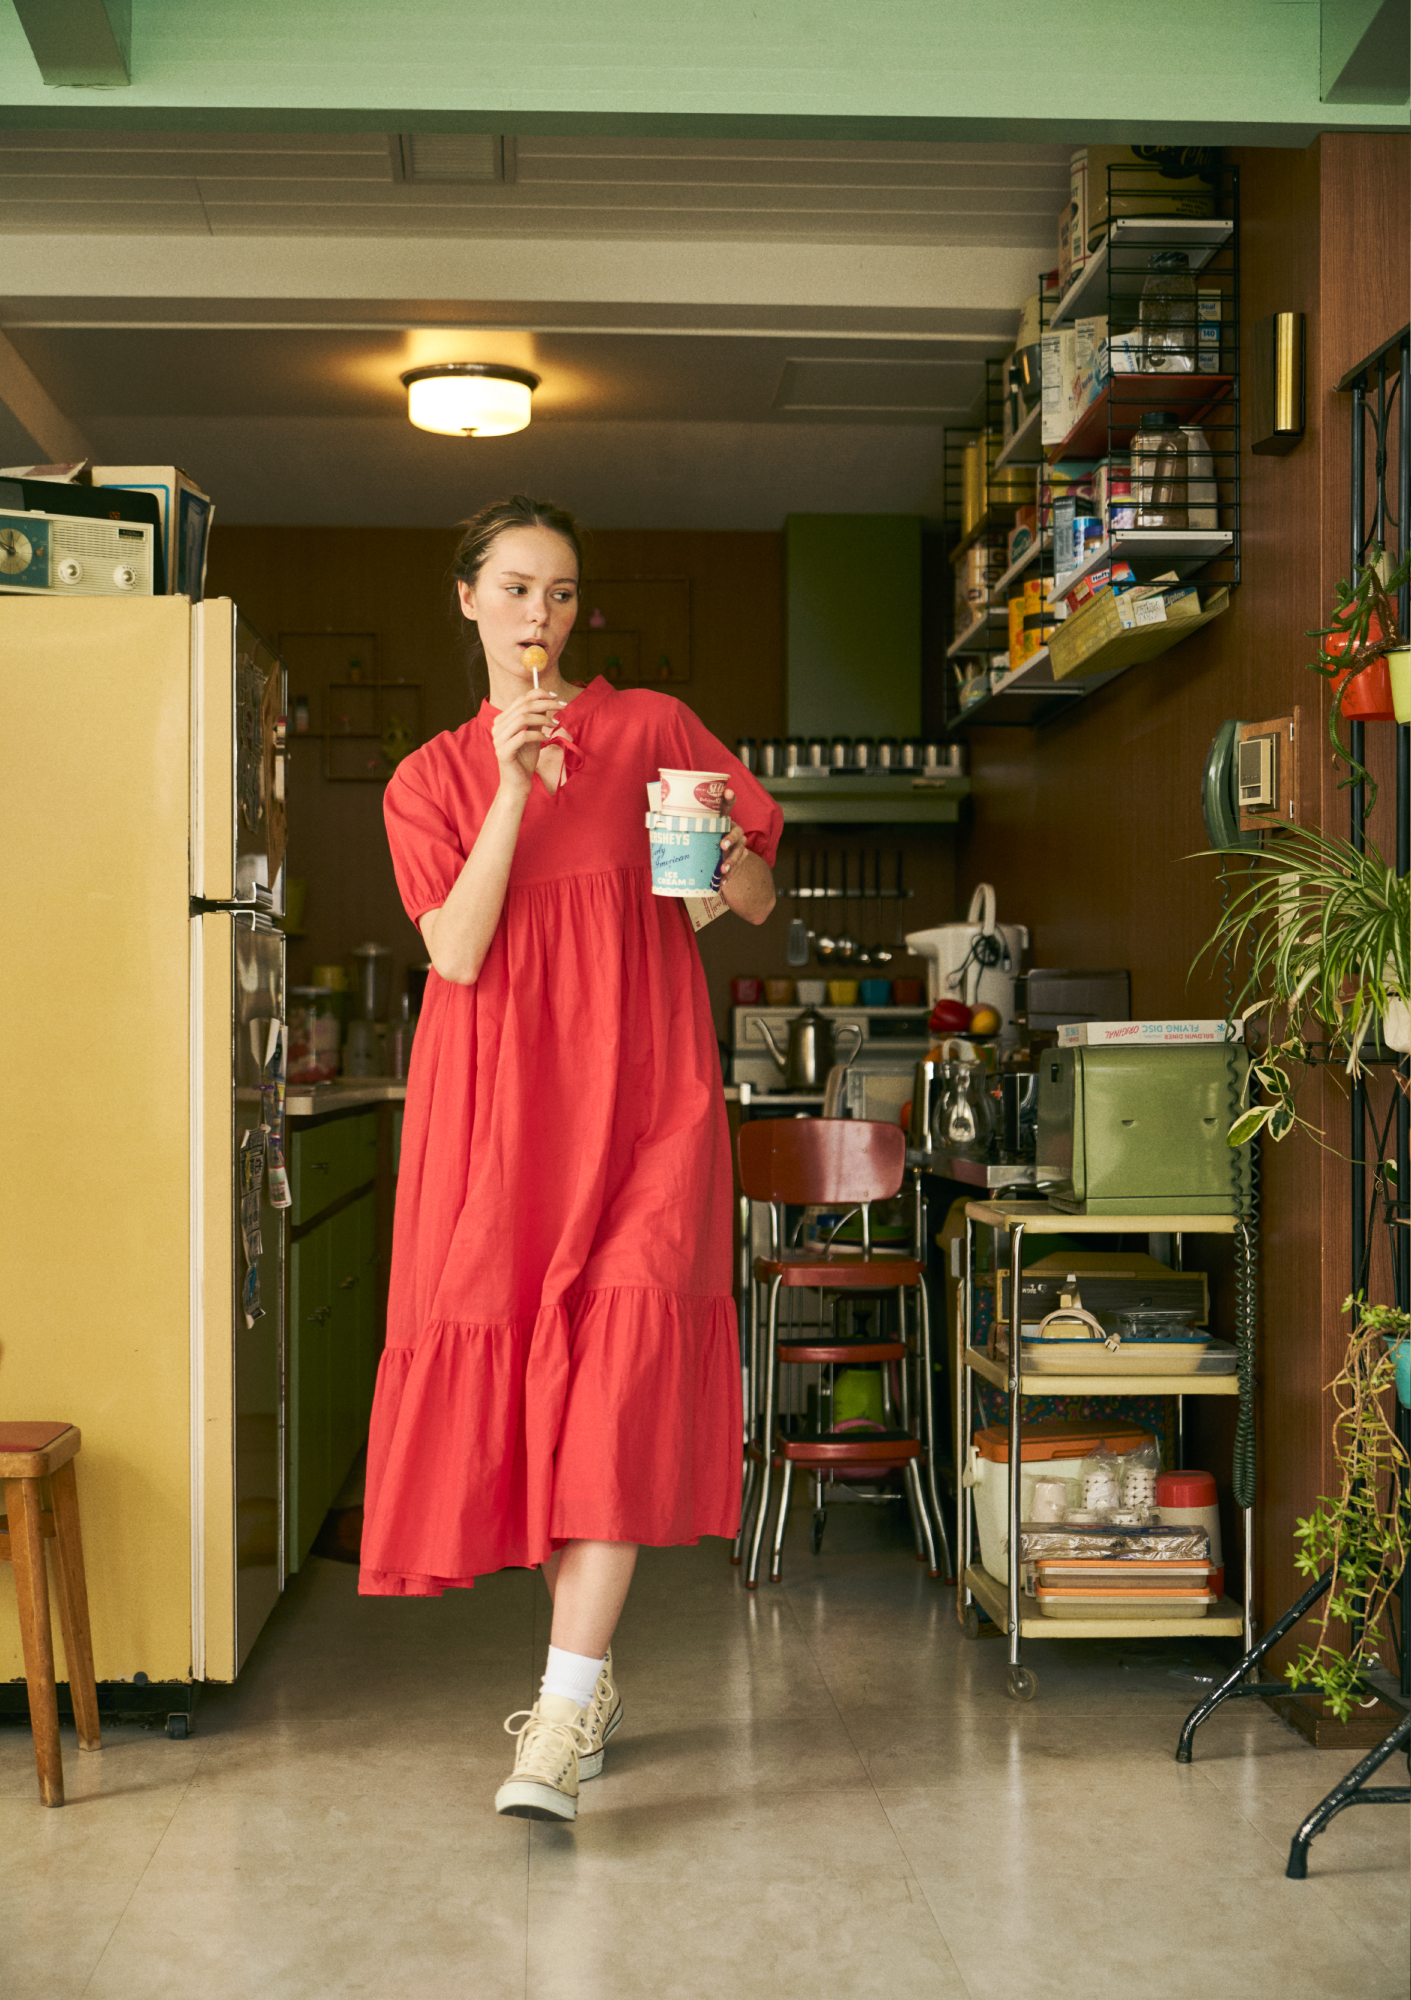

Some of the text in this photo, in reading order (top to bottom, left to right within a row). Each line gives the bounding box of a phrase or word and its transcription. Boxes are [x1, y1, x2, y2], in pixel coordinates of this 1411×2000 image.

[1203, 330, 1215, 338] 140
[650, 831, 690, 846] ERSHEY'S
[653, 854, 690, 870] American
[665, 871, 678, 879] ICE
[657, 877, 687, 886] CREAM
[1105, 1024, 1199, 1039] FLYING DISC ORIGINAL
